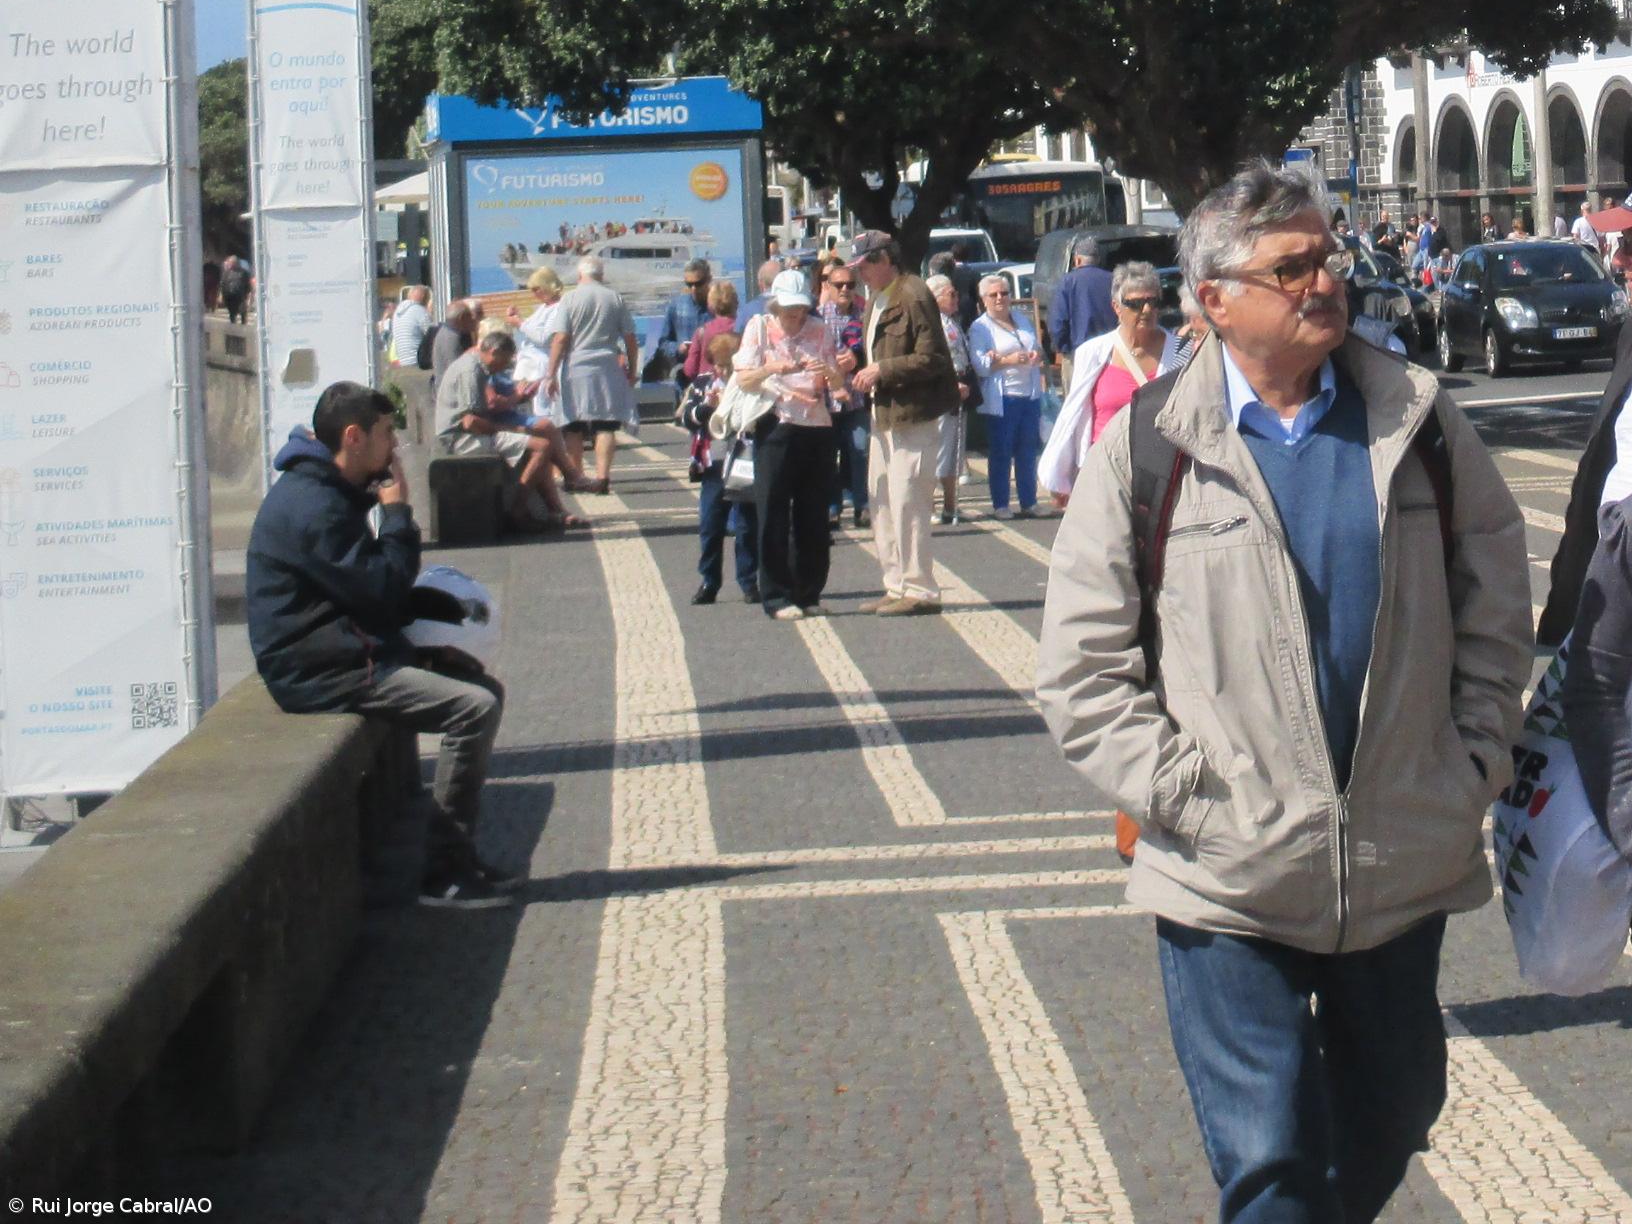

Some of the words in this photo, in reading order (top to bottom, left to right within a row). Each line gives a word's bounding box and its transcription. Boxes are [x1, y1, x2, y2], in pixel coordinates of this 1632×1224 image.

[10, 33, 56, 57] The
[67, 29, 135, 54] world
[270, 51, 283, 68] O
[288, 50, 346, 67] mundo
[58, 74, 153, 103] through
[269, 76, 313, 91] entra
[318, 75, 348, 93] por
[629, 92, 688, 102] DVENTURES
[42, 115, 106, 142] here!
[279, 135, 304, 149] The
[307, 134, 345, 148] world
[270, 163, 299, 174] goes
[304, 158, 355, 174] through
[501, 172, 605, 190] FUTURISMO
[24, 198, 110, 213] RESTAURAÇÃO
[25, 214, 103, 227] RESTAURANTS
[26, 254, 64, 265] BARES
[26, 267, 56, 279] BARS
[29, 306, 95, 317] PRODUTOS
[96, 302, 161, 315] REGIONAIS
[29, 319, 82, 332] AZOREAN
[84, 317, 142, 329] PRODUCTS
[30, 358, 92, 373] COMÉRCIO
[32, 374, 91, 386] SHOPPING
[31, 413, 67, 425] LAZER
[31, 427, 77, 439] LEISURE
[33, 465, 89, 478] SERVIÇOS
[34, 479, 85, 492] SERVICES
[35, 519, 104, 532] ATIVIDADES
[35, 535, 56, 547] SEA
[58, 532, 118, 545] ACTIVITIES
[37, 569, 145, 585] ENTRETENIMENTO
[38, 584, 131, 599] ENTERTAINMENT
[75, 685, 113, 697] VISITE
[42, 702, 85, 713] NOSSO
[88, 700, 113, 711] SITE
